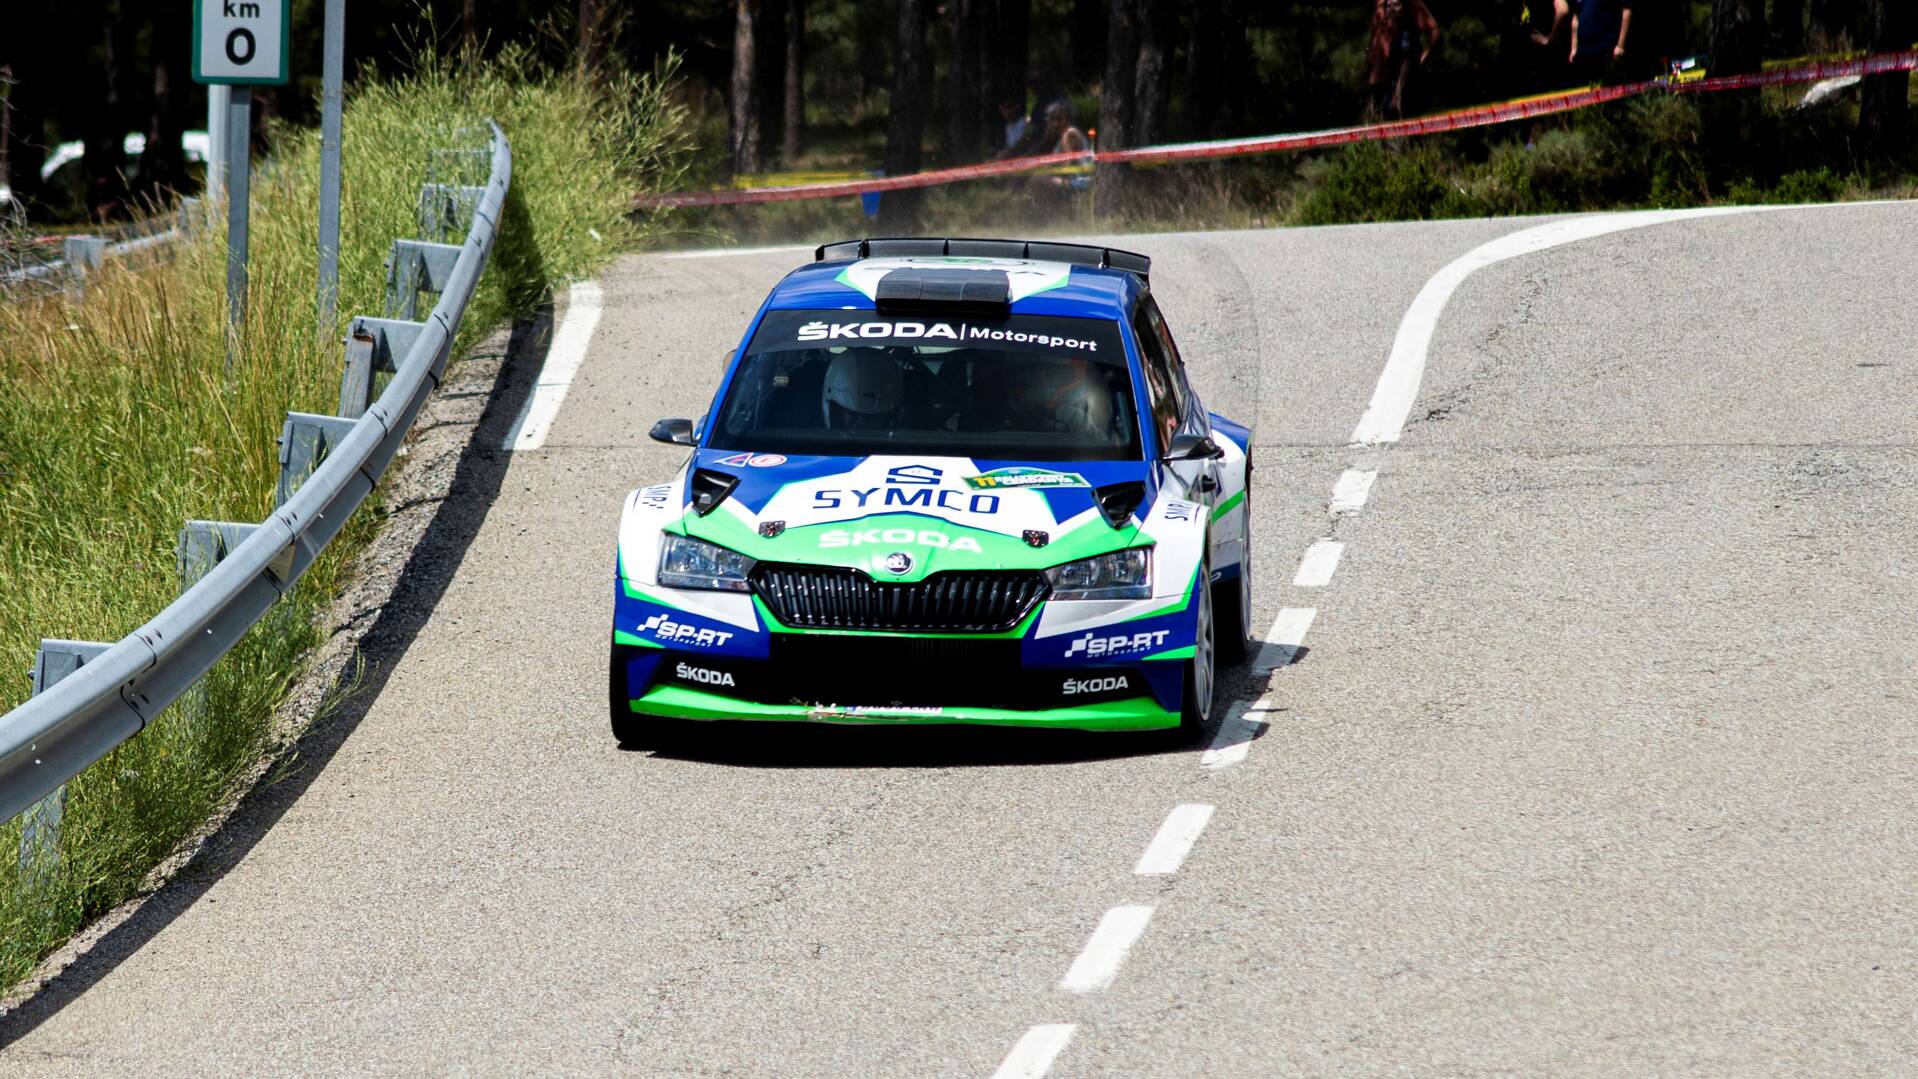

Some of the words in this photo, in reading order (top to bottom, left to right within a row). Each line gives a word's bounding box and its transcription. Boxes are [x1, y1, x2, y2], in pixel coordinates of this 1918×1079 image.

[223, 0, 260, 18] km
[797, 322, 958, 341] ŠKODA
[970, 327, 1098, 351] Motorsport
[812, 487, 1001, 515] SYMCO
[818, 528, 983, 554] ŠKODA
[676, 662, 736, 687] ŠKODA
[1062, 676, 1129, 695] ŠKODA
